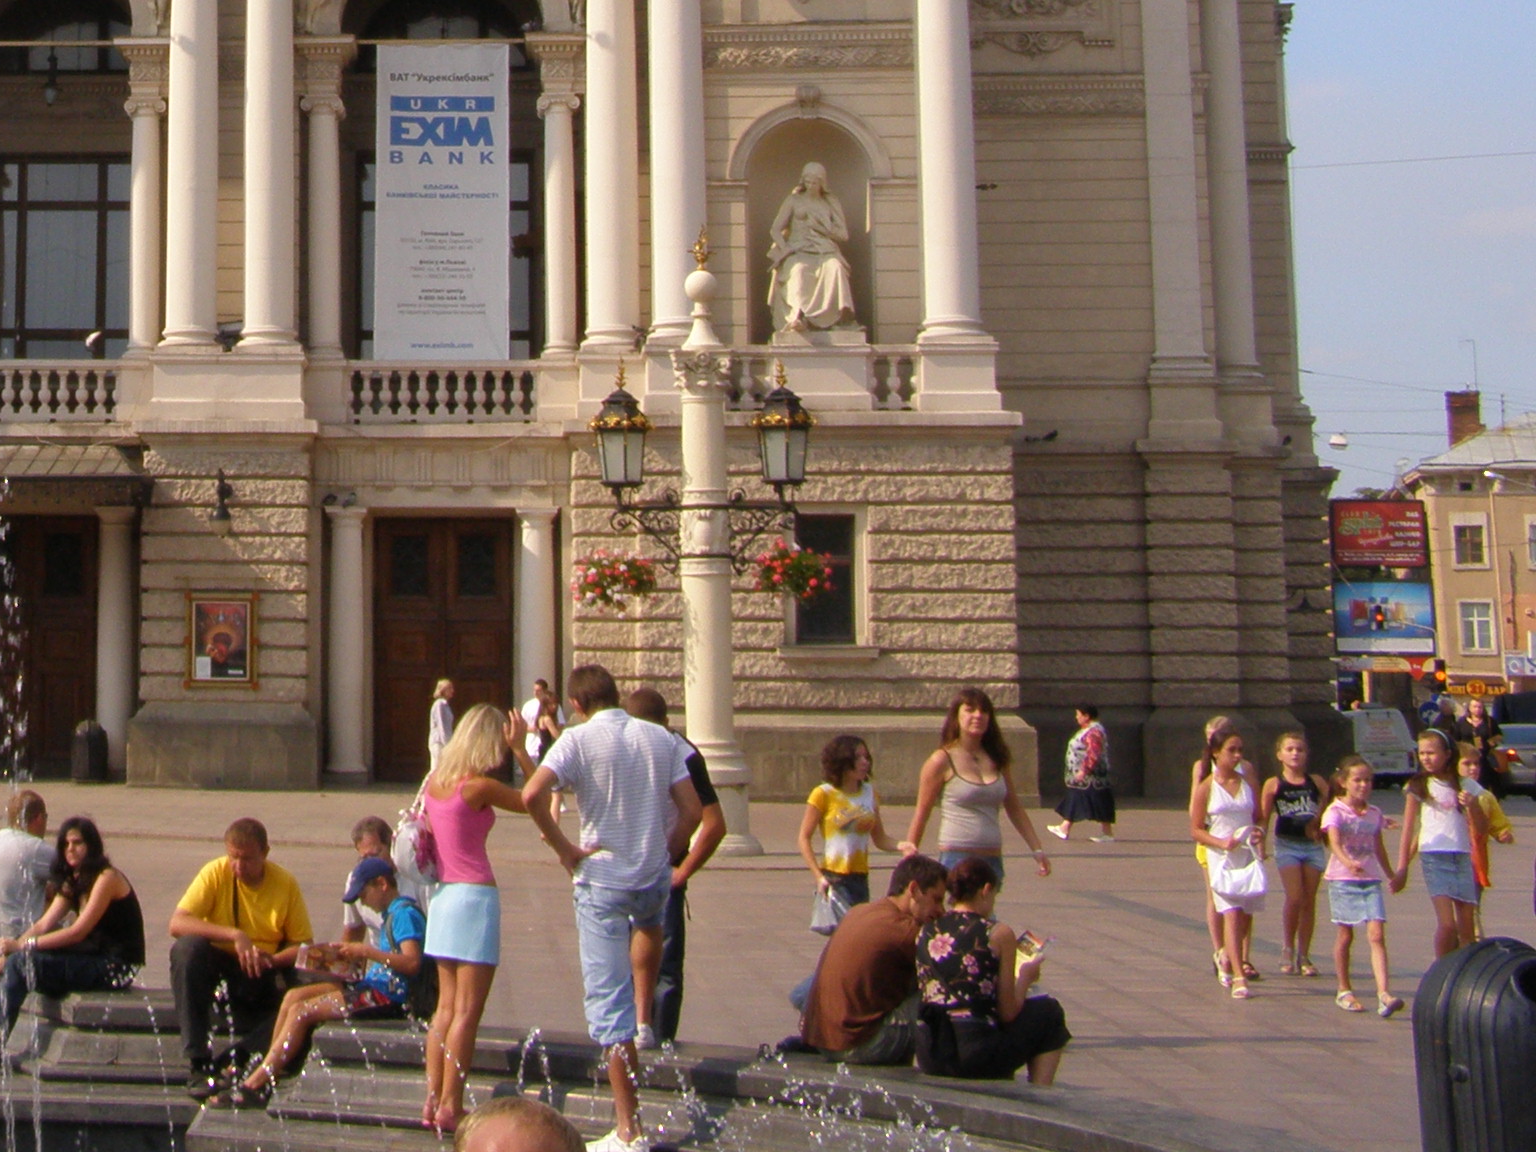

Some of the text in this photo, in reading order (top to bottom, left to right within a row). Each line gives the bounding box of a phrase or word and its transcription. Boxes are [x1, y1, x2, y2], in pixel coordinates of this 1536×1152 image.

[390, 72, 409, 82] ВАТ
[410, 99, 476, 110] UKR
[390, 116, 494, 147] EXIM
[389, 150, 495, 165] BANK
